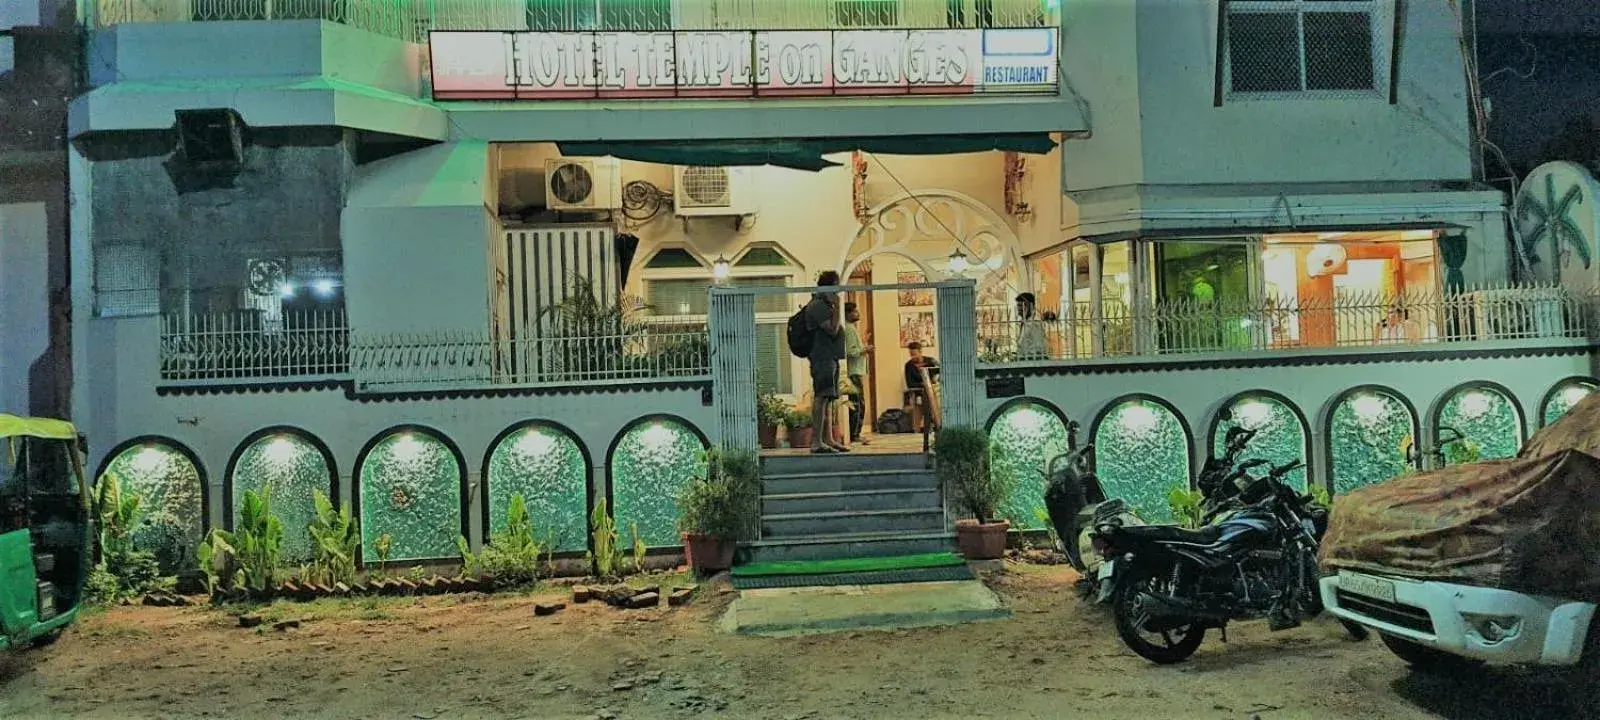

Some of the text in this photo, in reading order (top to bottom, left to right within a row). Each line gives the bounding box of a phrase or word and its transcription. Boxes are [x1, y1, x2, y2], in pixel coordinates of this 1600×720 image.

[503, 31, 968, 88] HOTEL TEMPLE on GANGES
[985, 66, 1048, 82] RESTAURANT
